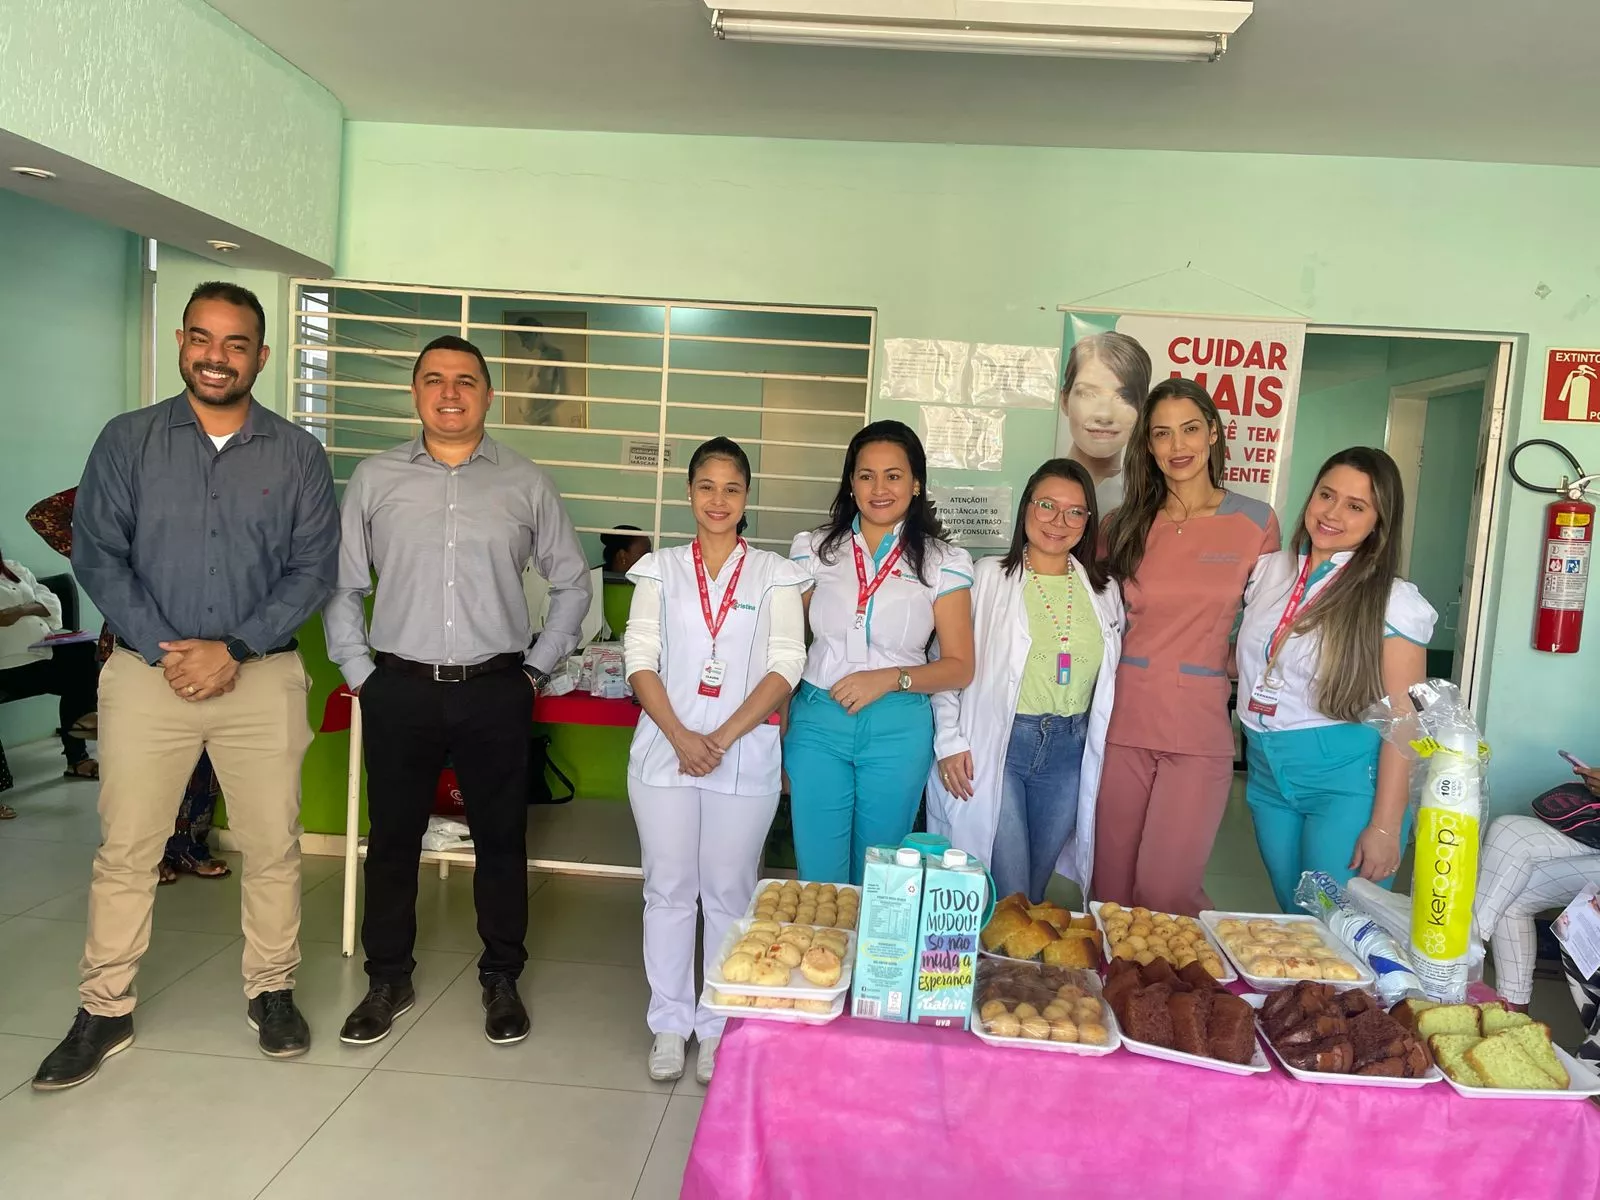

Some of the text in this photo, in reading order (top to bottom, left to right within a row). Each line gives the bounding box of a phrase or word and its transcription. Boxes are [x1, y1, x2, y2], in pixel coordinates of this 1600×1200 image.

[1168, 336, 1287, 370] CUIDAR
[1247, 426, 1280, 443] TEM
[1243, 446, 1276, 463] VER
[1440, 779, 1451, 796] 100
[929, 887, 980, 913] TUDO
[926, 912, 977, 932] MUDOU!
[922, 949, 960, 970] muda
[963, 954, 972, 968] a
